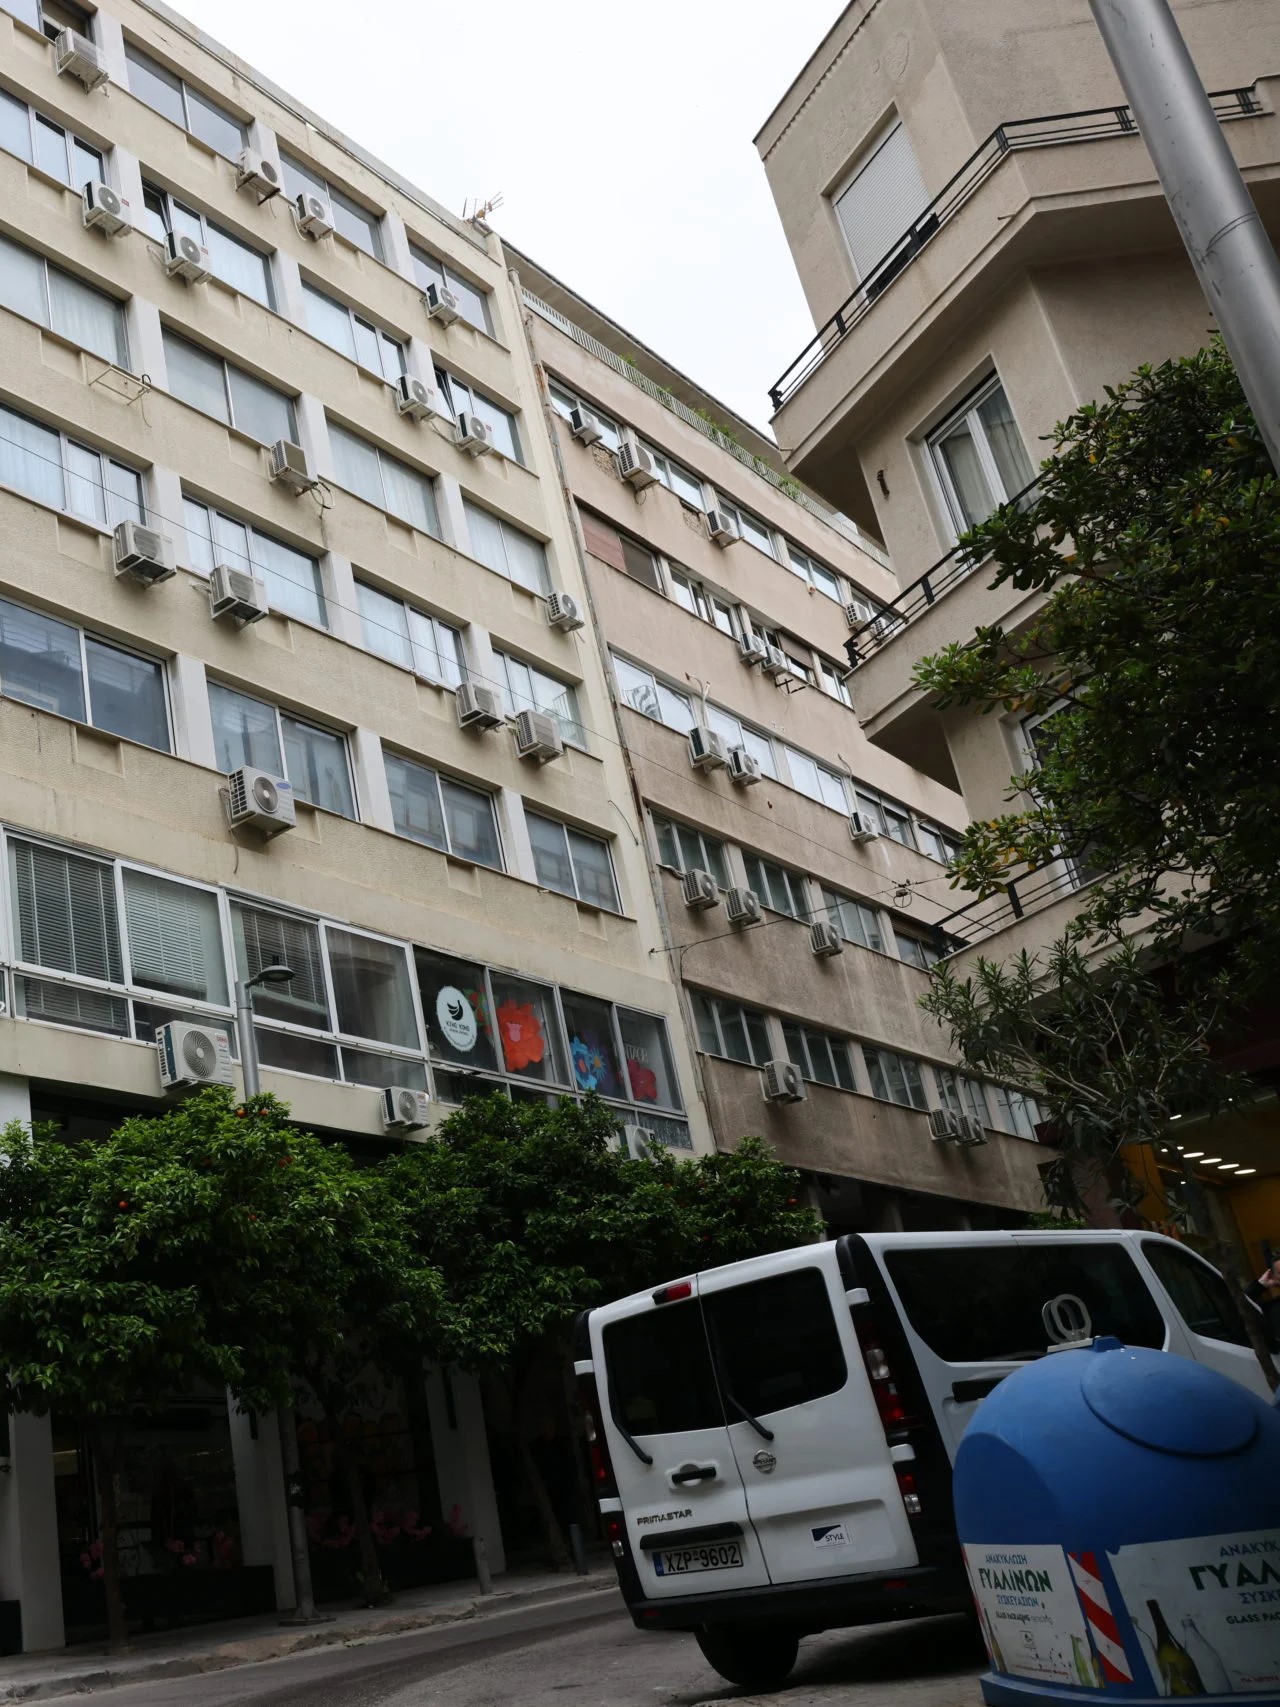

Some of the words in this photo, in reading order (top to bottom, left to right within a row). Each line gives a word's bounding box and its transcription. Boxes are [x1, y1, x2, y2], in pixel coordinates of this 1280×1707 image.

[637, 1509, 693, 1526] PRIMASTAR
[825, 1533, 845, 1542] STYLE
[978, 1567, 1053, 1593] ΓΥΑΛΙΝΩΝ
[1226, 1613, 1260, 1624] GLASS
